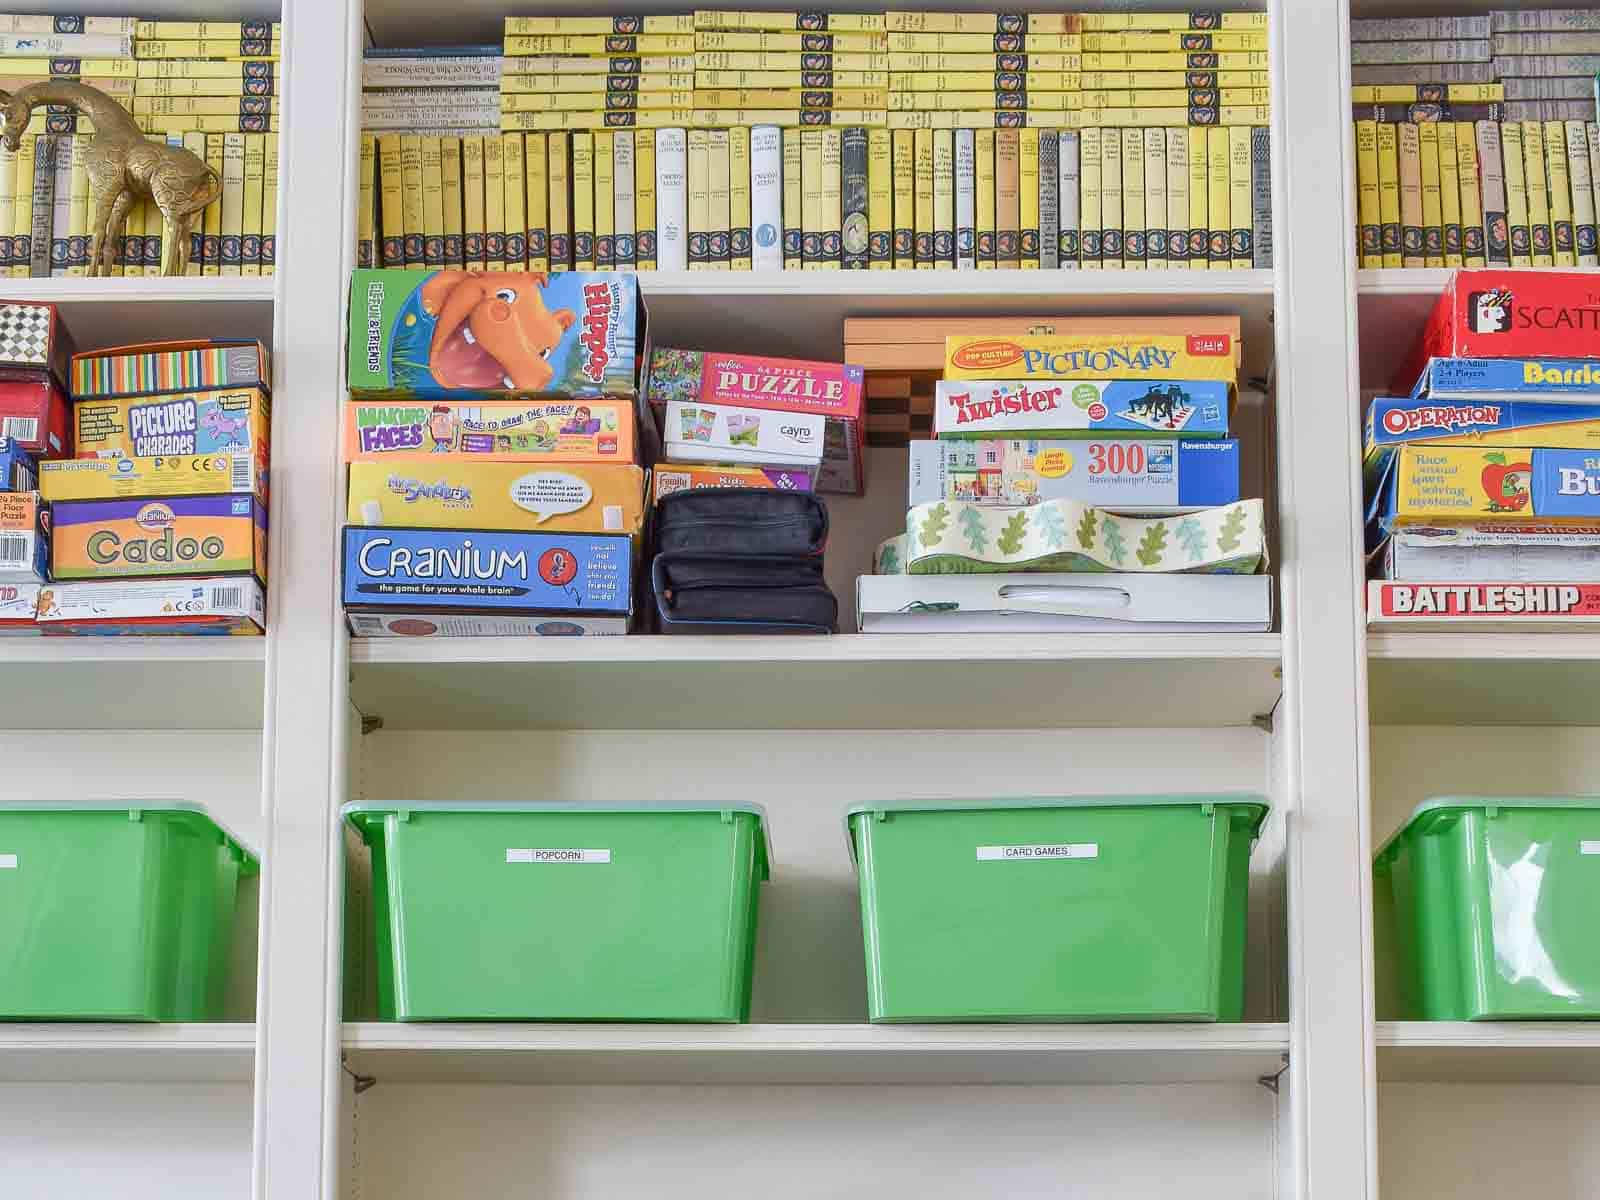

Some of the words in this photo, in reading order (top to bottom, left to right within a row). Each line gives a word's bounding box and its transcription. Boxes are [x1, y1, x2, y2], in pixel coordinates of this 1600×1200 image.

[464, 65, 481, 74] TALE
[580, 283, 611, 383] Hippos
[368, 329, 381, 373] FRIENDS
[966, 352, 981, 361] POP
[1022, 348, 1177, 375] PICTIONARY
[769, 367, 813, 378] PIECE
[1439, 369, 1452, 377] 2-4
[1455, 369, 1485, 378] Players
[716, 370, 844, 401] PUZZLE
[949, 386, 1062, 425] Twister
[131, 399, 196, 439] PICTURE
[463, 419, 484, 431] RACE
[487, 422, 498, 431] TO
[501, 414, 524, 429] DRAW
[526, 409, 543, 421] THE
[1383, 407, 1499, 434] OPERATION
[362, 424, 423, 452] FACES
[780, 425, 811, 437] cayro
[136, 434, 194, 457] CHARADES
[1181, 441, 1234, 451] Ravensburger
[1088, 443, 1145, 474] 300
[1416, 454, 1448, 465] Race
[4, 503, 24, 511] Floor
[0, 511, 26, 521] Puzzle
[86, 528, 224, 564] Cadoo
[379, 584, 393, 592] the
[395, 585, 419, 593] game
[422, 583, 434, 592] for
[436, 585, 457, 594] your
[459, 584, 485, 594] whole
[487, 585, 511, 595] brain
[587, 582, 616, 590] friends
[1393, 585, 1580, 613] BATTLESHIP
[535, 851, 581, 860] POPCORN
[1005, 847, 1032, 857] CARD
[1034, 846, 1068, 856] GAMES
